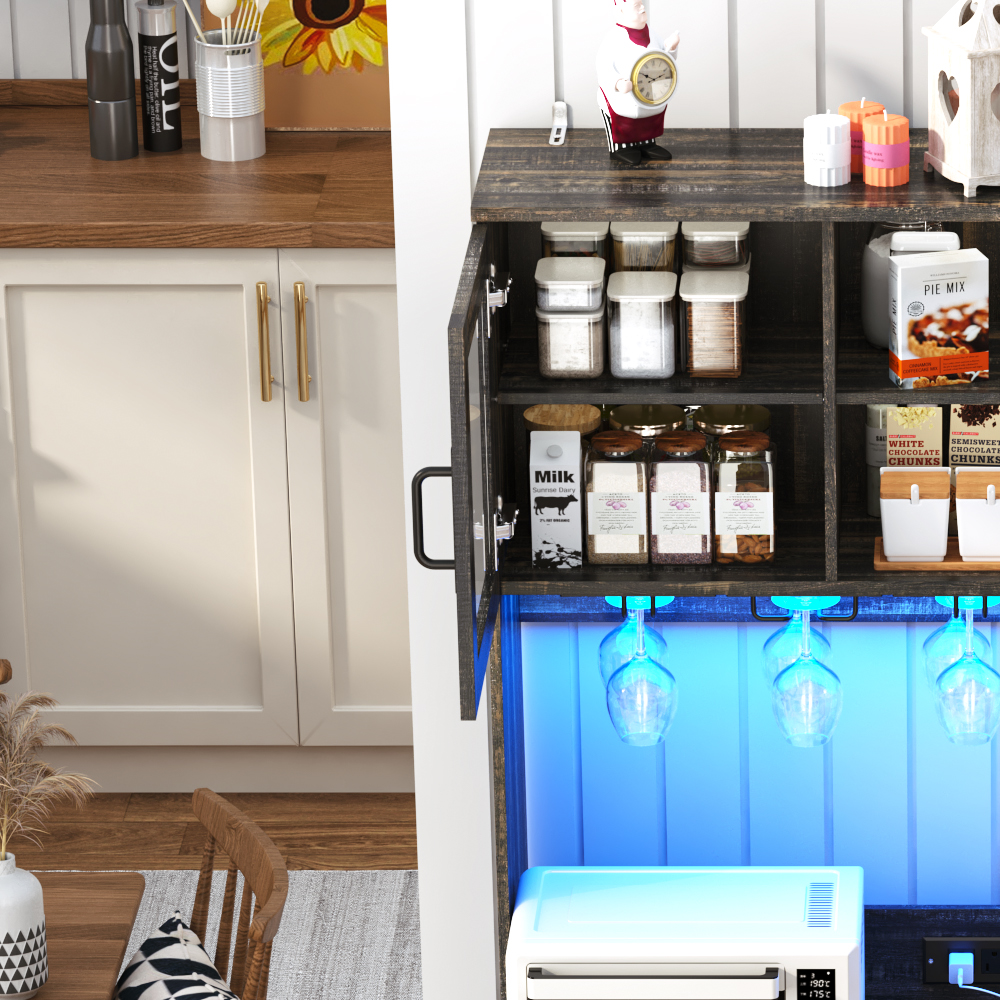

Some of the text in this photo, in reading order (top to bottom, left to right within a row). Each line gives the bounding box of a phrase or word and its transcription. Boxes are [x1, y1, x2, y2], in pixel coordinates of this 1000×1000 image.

[924, 281, 966, 296] PIE MIX
[888, 440, 925, 448] WHITE
[888, 457, 941, 466] CHUNKS
[535, 470, 576, 484] Milk
